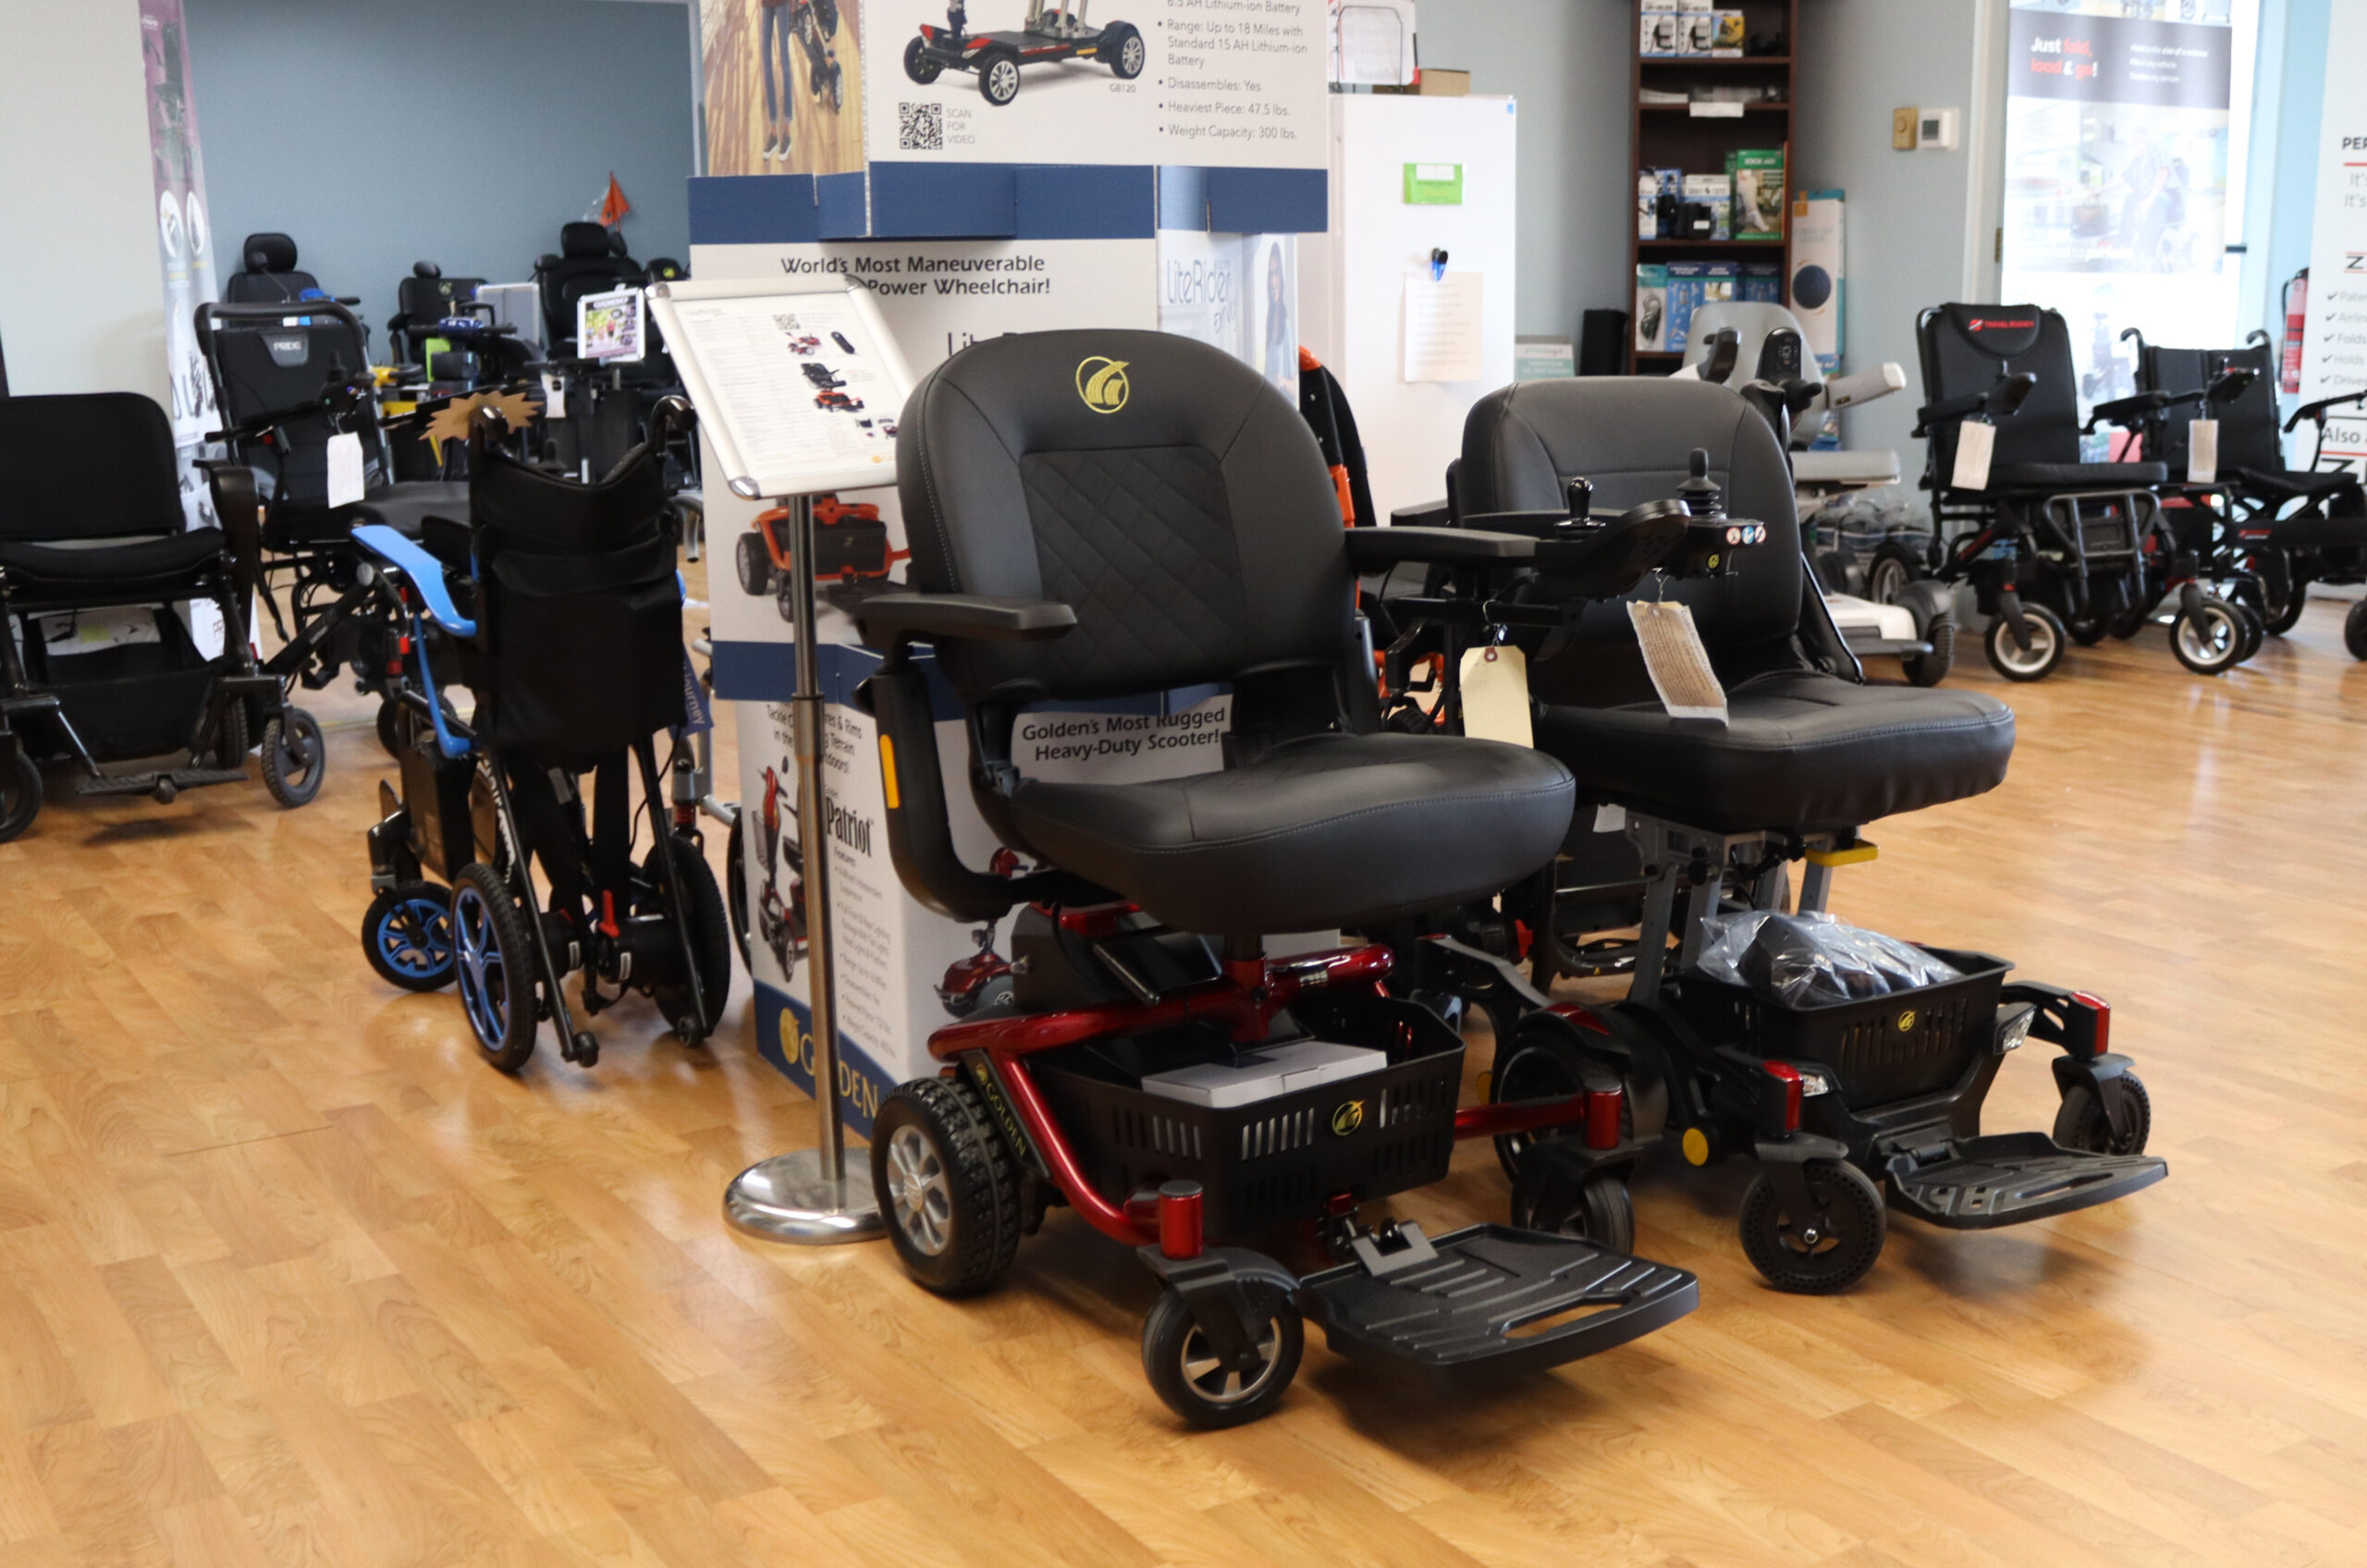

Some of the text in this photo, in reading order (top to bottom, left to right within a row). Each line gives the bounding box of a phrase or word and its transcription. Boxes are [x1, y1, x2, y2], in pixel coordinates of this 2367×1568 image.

[1185, 0, 1203, 8] AH
[1205, 0, 1263, 12] Lithium-ion
[1265, 1, 1301, 16] Battery
[1167, 18, 1304, 37] Range: Up to 18 Miles with
[1167, 36, 1308, 54] Standard 15 AH Lithium-ion
[2030, 37, 2062, 54] Just
[1167, 54, 1205, 68] Battery
[2030, 57, 2098, 80] load & go!
[1167, 77, 1262, 92] Disassembles: Yes
[946, 108, 973, 119] SCAN
[1167, 101, 1290, 116] Heaviest Piece: 47.5 lbs.
[946, 121, 966, 132] FOR
[1168, 124, 1297, 141] Weight Capacity: 300 lbs.
[946, 134, 976, 145] VIDEO
[780, 255, 1046, 274] World's Most Maneuverable
[868, 277, 1051, 296] Power Wheelchair!
[1166, 258, 1232, 304] LiteRider
[2323, 426, 2361, 444] Also
[1022, 706, 1226, 741] Golden's Most Rugged
[1035, 729, 1220, 762] Heavy-Duty Scooter!
[825, 795, 873, 858] Patriot
[800, 1032, 879, 1120] GDEN
[986, 1082, 1027, 1158] GOLDEN
